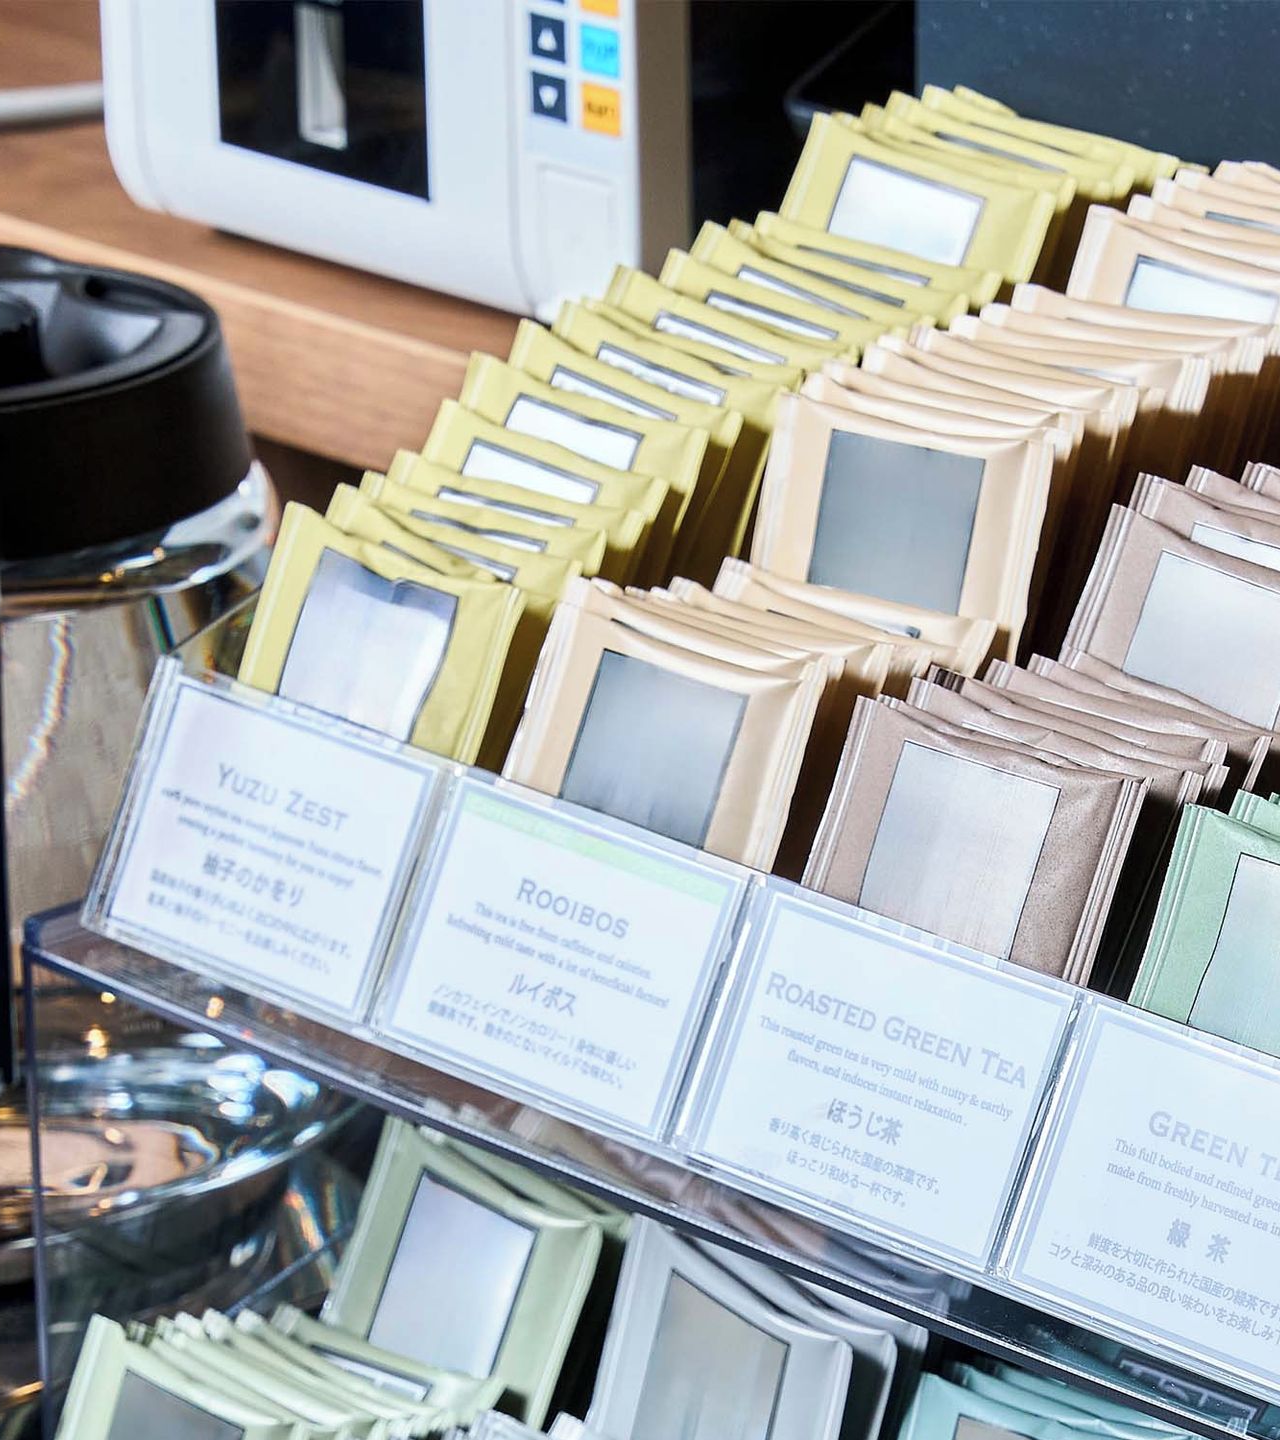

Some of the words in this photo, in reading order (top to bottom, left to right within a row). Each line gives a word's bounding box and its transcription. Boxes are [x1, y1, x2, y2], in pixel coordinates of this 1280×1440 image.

[218, 762, 278, 806] YUZU
[284, 789, 349, 832] ZEST
[515, 877, 630, 940] ROOIBOS
[507, 973, 577, 1018] ルイボス
[765, 971, 877, 1032] ROASTED
[883, 1016, 972, 1068] GREEN
[981, 1047, 1026, 1089] TEA
[826, 1097, 904, 1147] ほうじ茶
[1148, 1110, 1249, 1169] GREEN
[786, 1149, 906, 1208] ほっこり和める一杯です。
[1106, 1162, 1137, 1181] made
[1136, 1170, 1162, 1192] from
[1162, 1180, 1201, 1209] freshly
[1200, 1194, 1253, 1225] harvested
[1252, 1217, 1269, 1232] tea
[1115, 1138, 1138, 1158] This
[1137, 1147, 1159, 1166] full
[1158, 1154, 1194, 1179] bodied
[1193, 1171, 1216, 1187] and
[1213, 1179, 1254, 1202] refined
